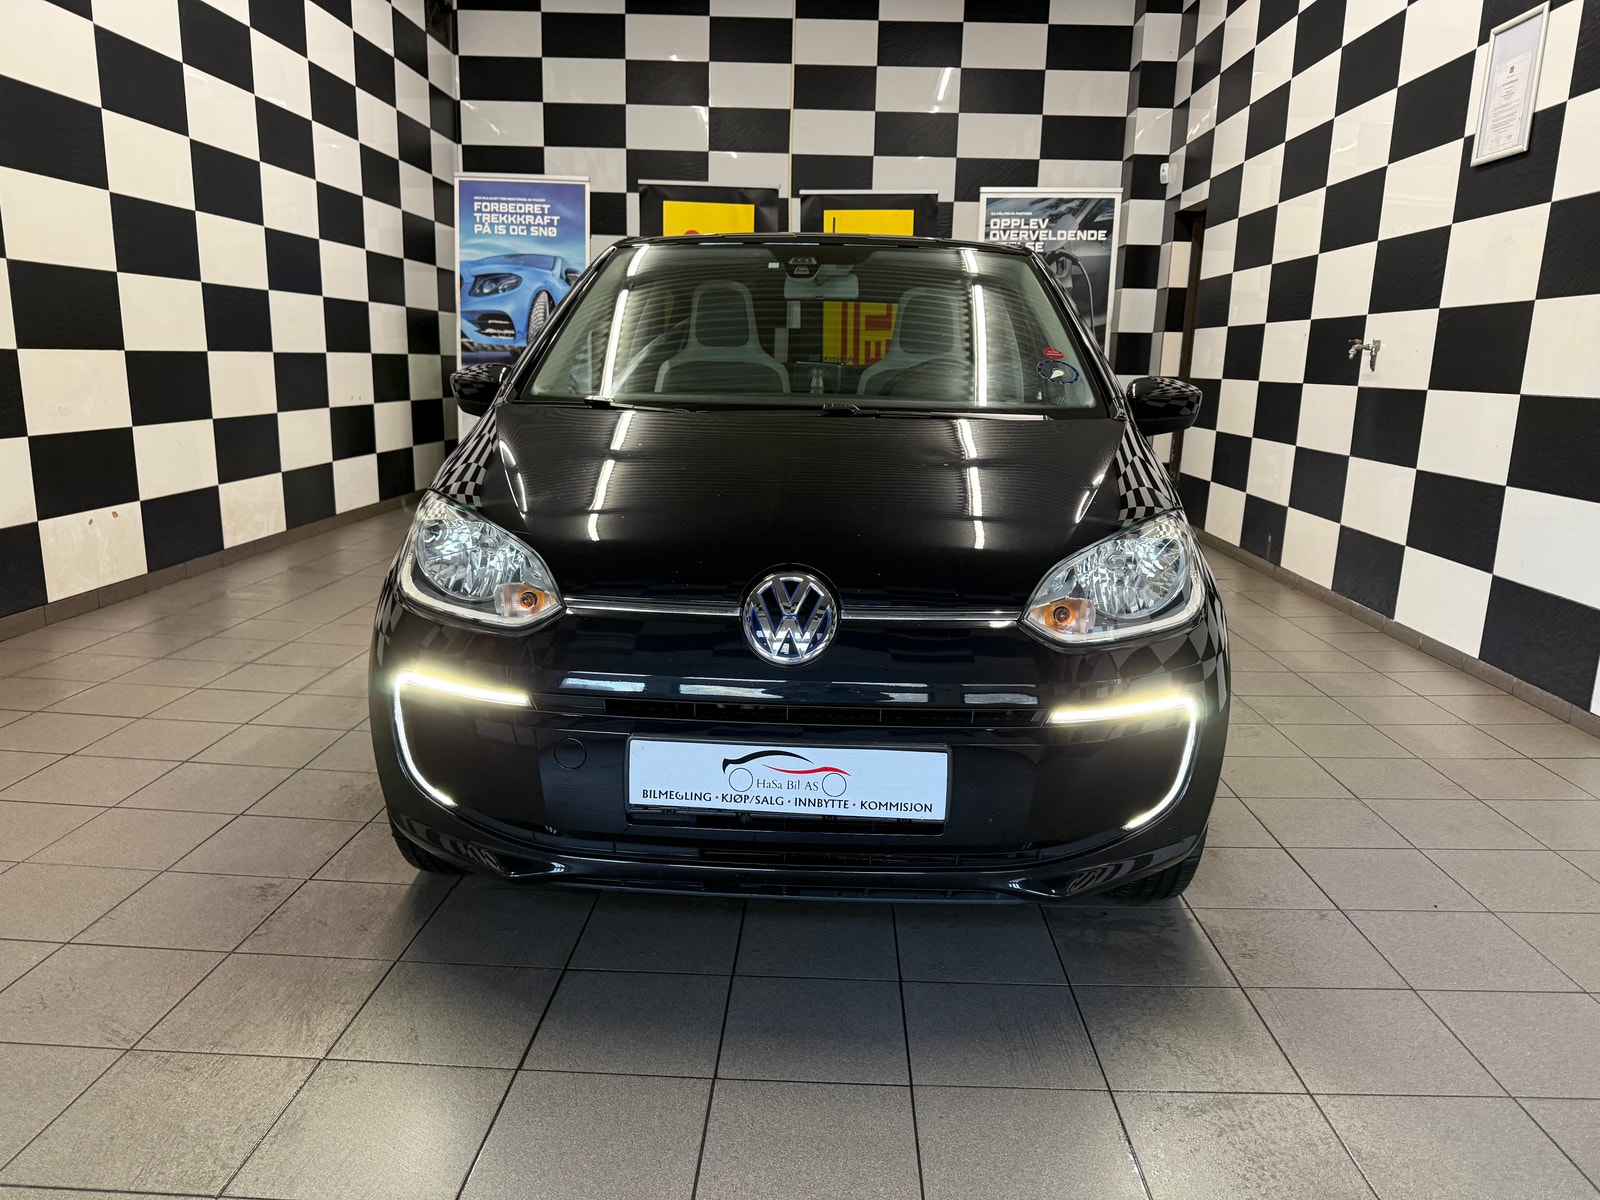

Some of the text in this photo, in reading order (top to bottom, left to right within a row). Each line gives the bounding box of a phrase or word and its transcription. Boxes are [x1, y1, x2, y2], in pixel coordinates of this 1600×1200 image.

[474, 202, 551, 214] FORBEDRET
[474, 213, 560, 226] TREKKKRAFT
[991, 218, 1049, 229] OPPLEV
[474, 222, 557, 237] PÅ IS OG SNØ
[991, 230, 1107, 240] OVERVELDENDE
[757, 779, 819, 791] HaSa Bil AS
[642, 789, 933, 813] BILMEGLING KJØP/SALG INNBYTTE KOMMISJON
